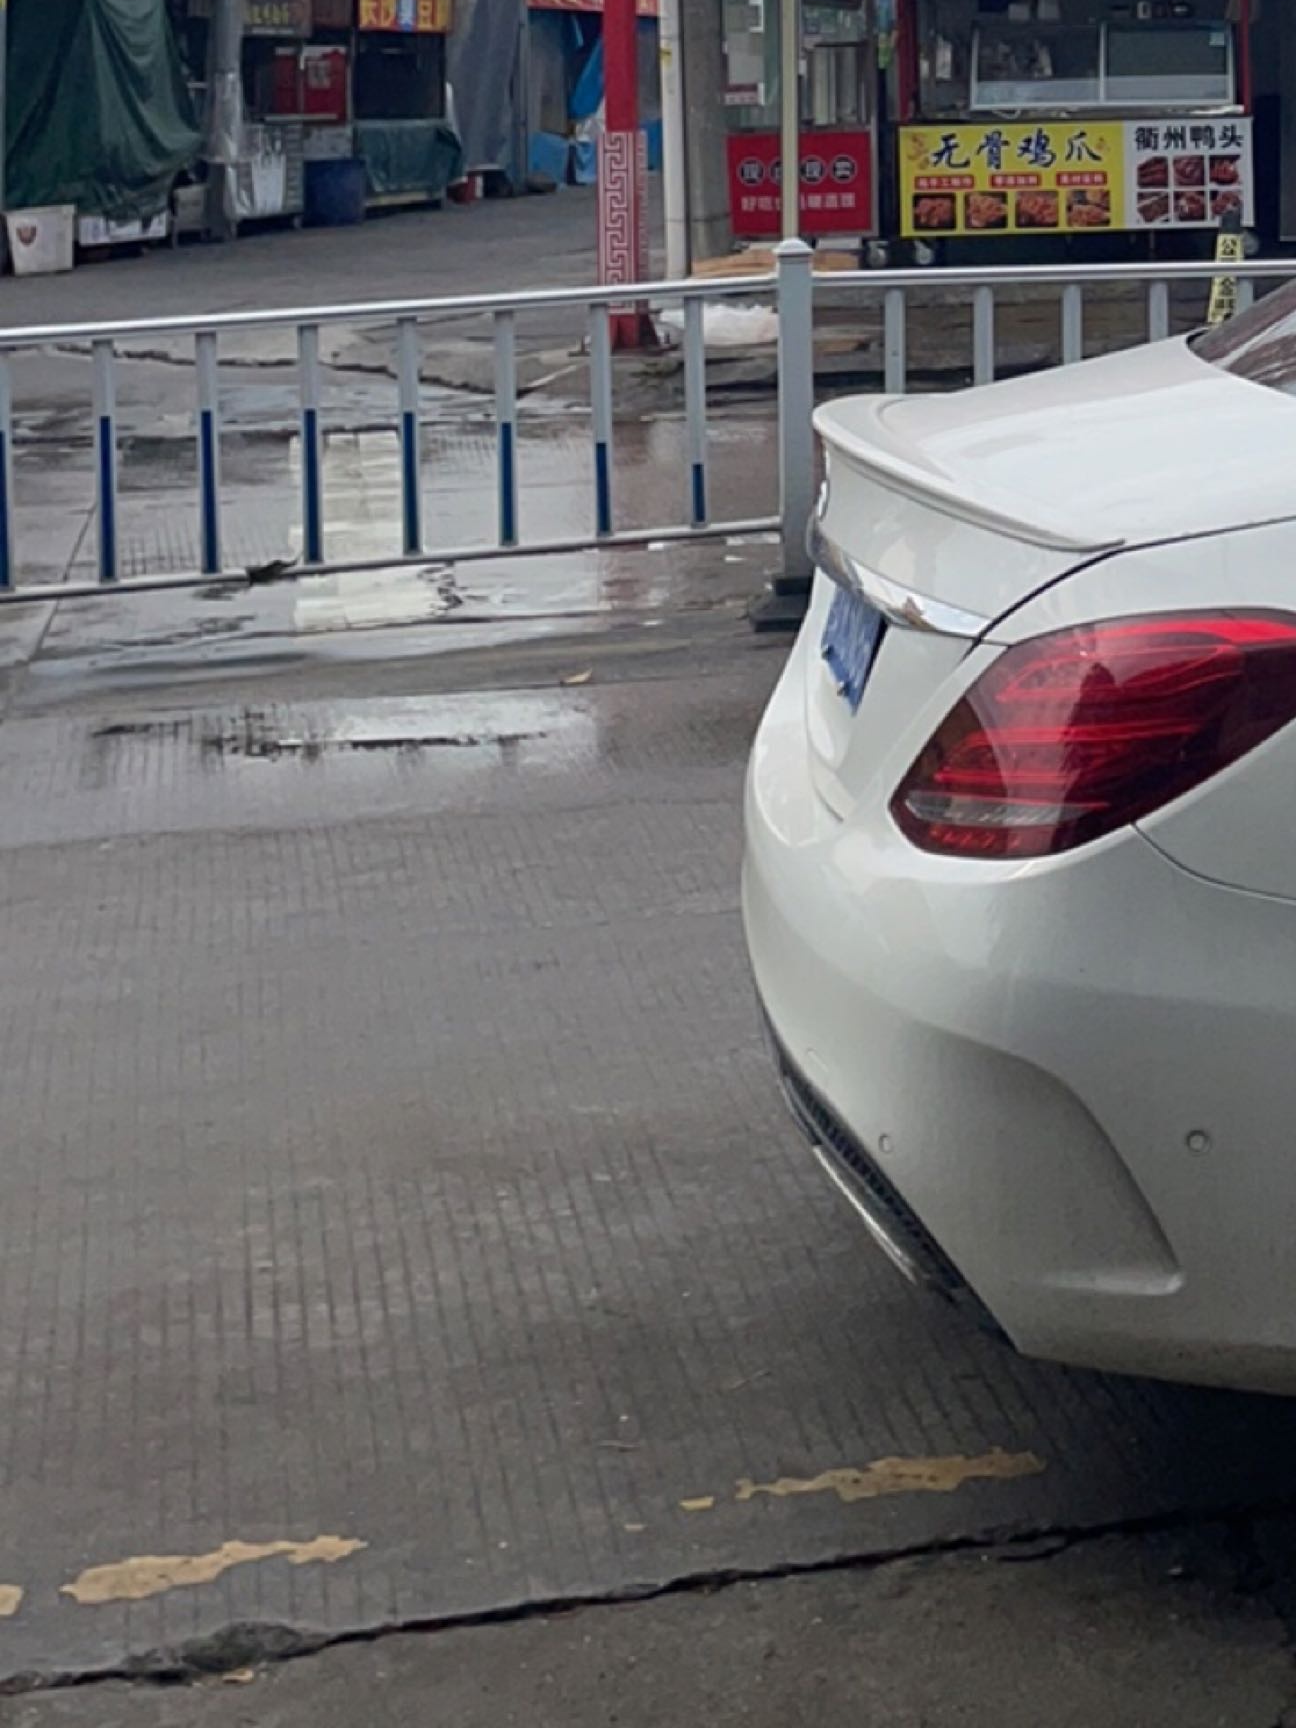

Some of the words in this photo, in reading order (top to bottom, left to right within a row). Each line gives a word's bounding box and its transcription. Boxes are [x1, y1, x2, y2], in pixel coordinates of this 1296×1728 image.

[930, 130, 1103, 170] 无骨鸡爪
[1135, 125, 1244, 151] 衢州鸭头
